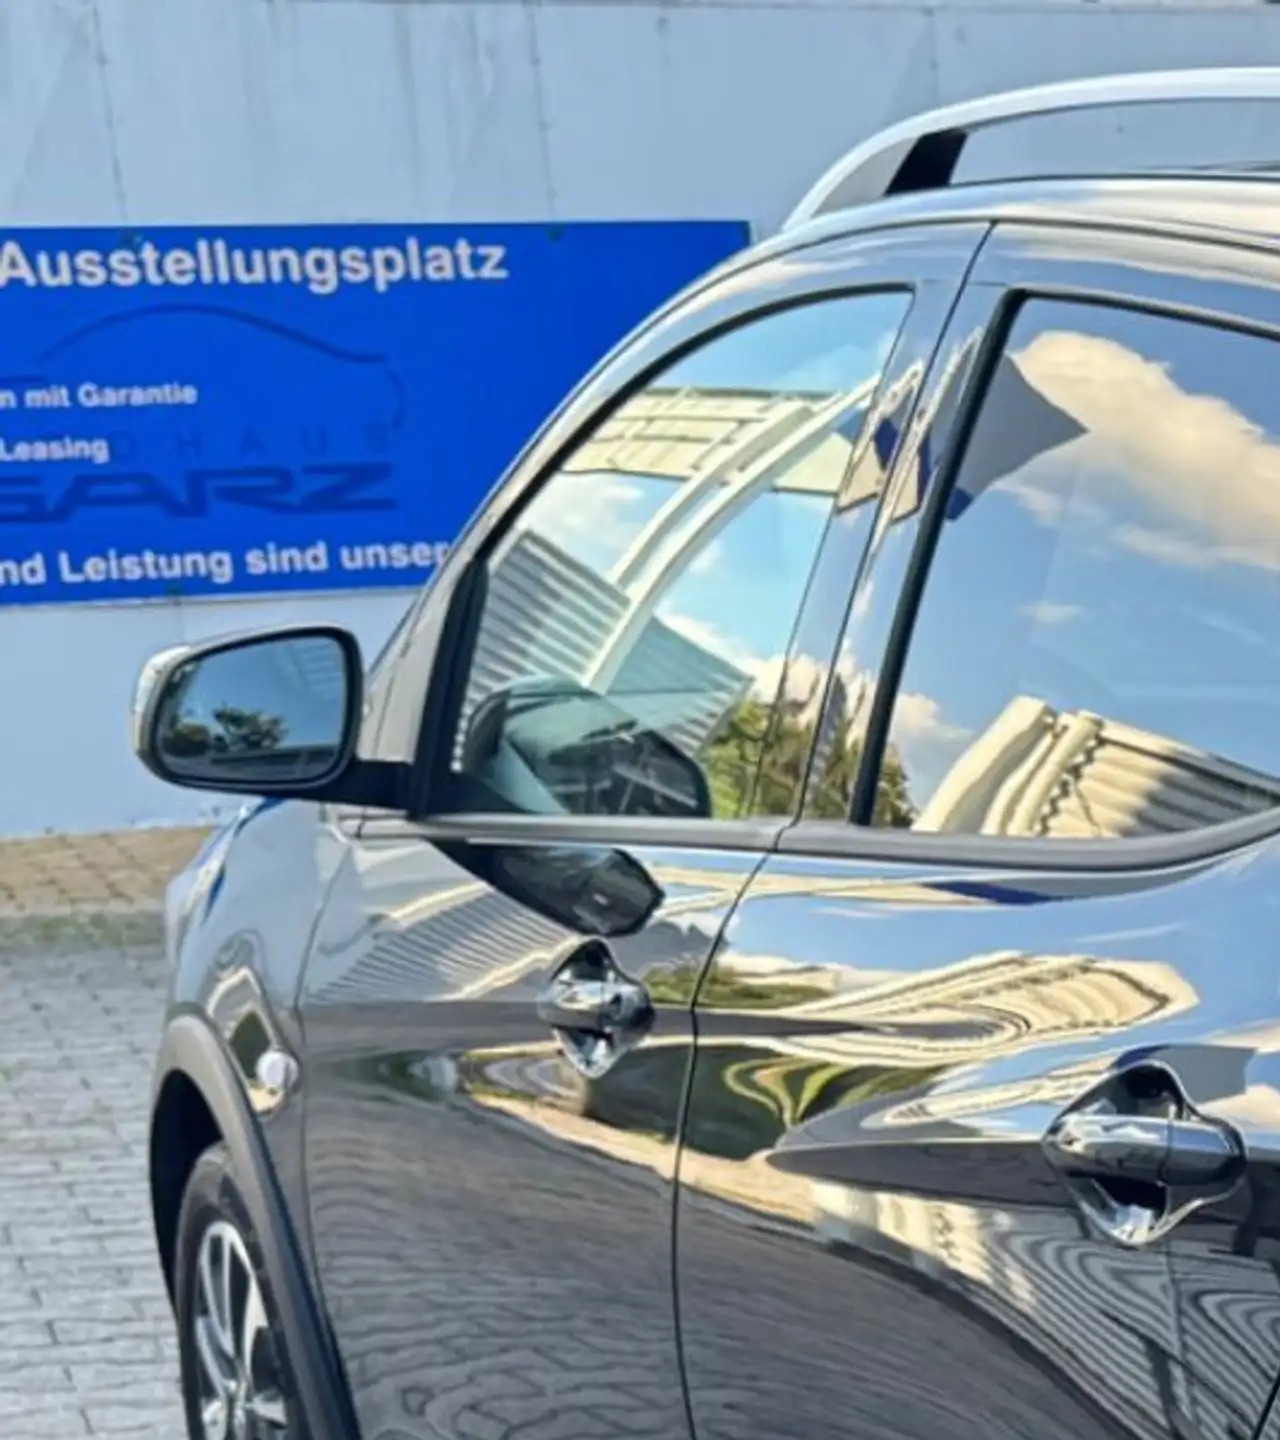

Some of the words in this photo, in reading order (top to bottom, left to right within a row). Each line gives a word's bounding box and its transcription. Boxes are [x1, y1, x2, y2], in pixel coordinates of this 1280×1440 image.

[0, 236, 510, 295] Ausstellungsplatz
[25, 383, 71, 408] mit
[77, 381, 198, 407] Garantie
[59, 548, 234, 584] Leistung
[245, 540, 330, 576] sind
